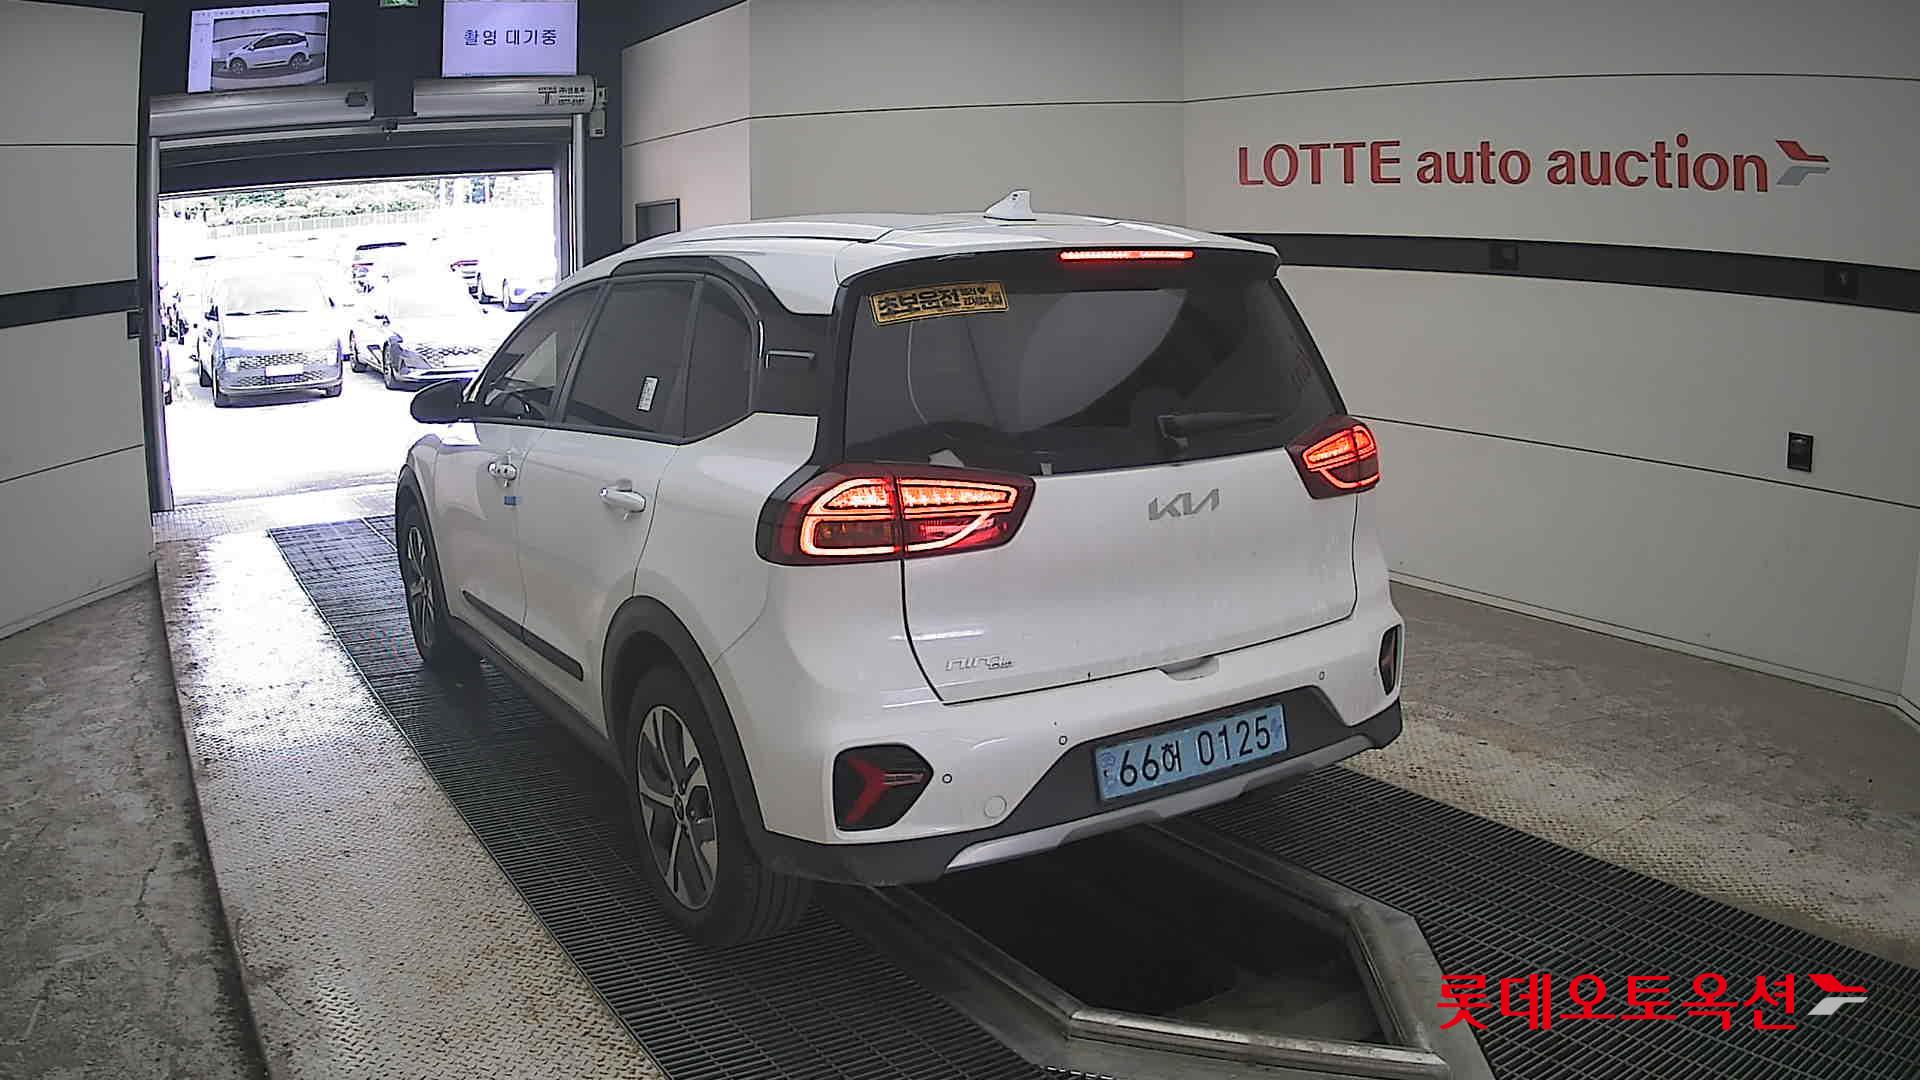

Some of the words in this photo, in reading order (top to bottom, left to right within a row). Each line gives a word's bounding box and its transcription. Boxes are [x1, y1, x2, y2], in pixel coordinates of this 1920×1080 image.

[505, 29, 557, 46] 대기중
[1238, 140, 1400, 187] LOTTE
[1416, 140, 1531, 186] auto
[1547, 133, 1768, 193] auction
[1119, 740, 1182, 787] 66허
[1198, 715, 1271, 766] 0125
